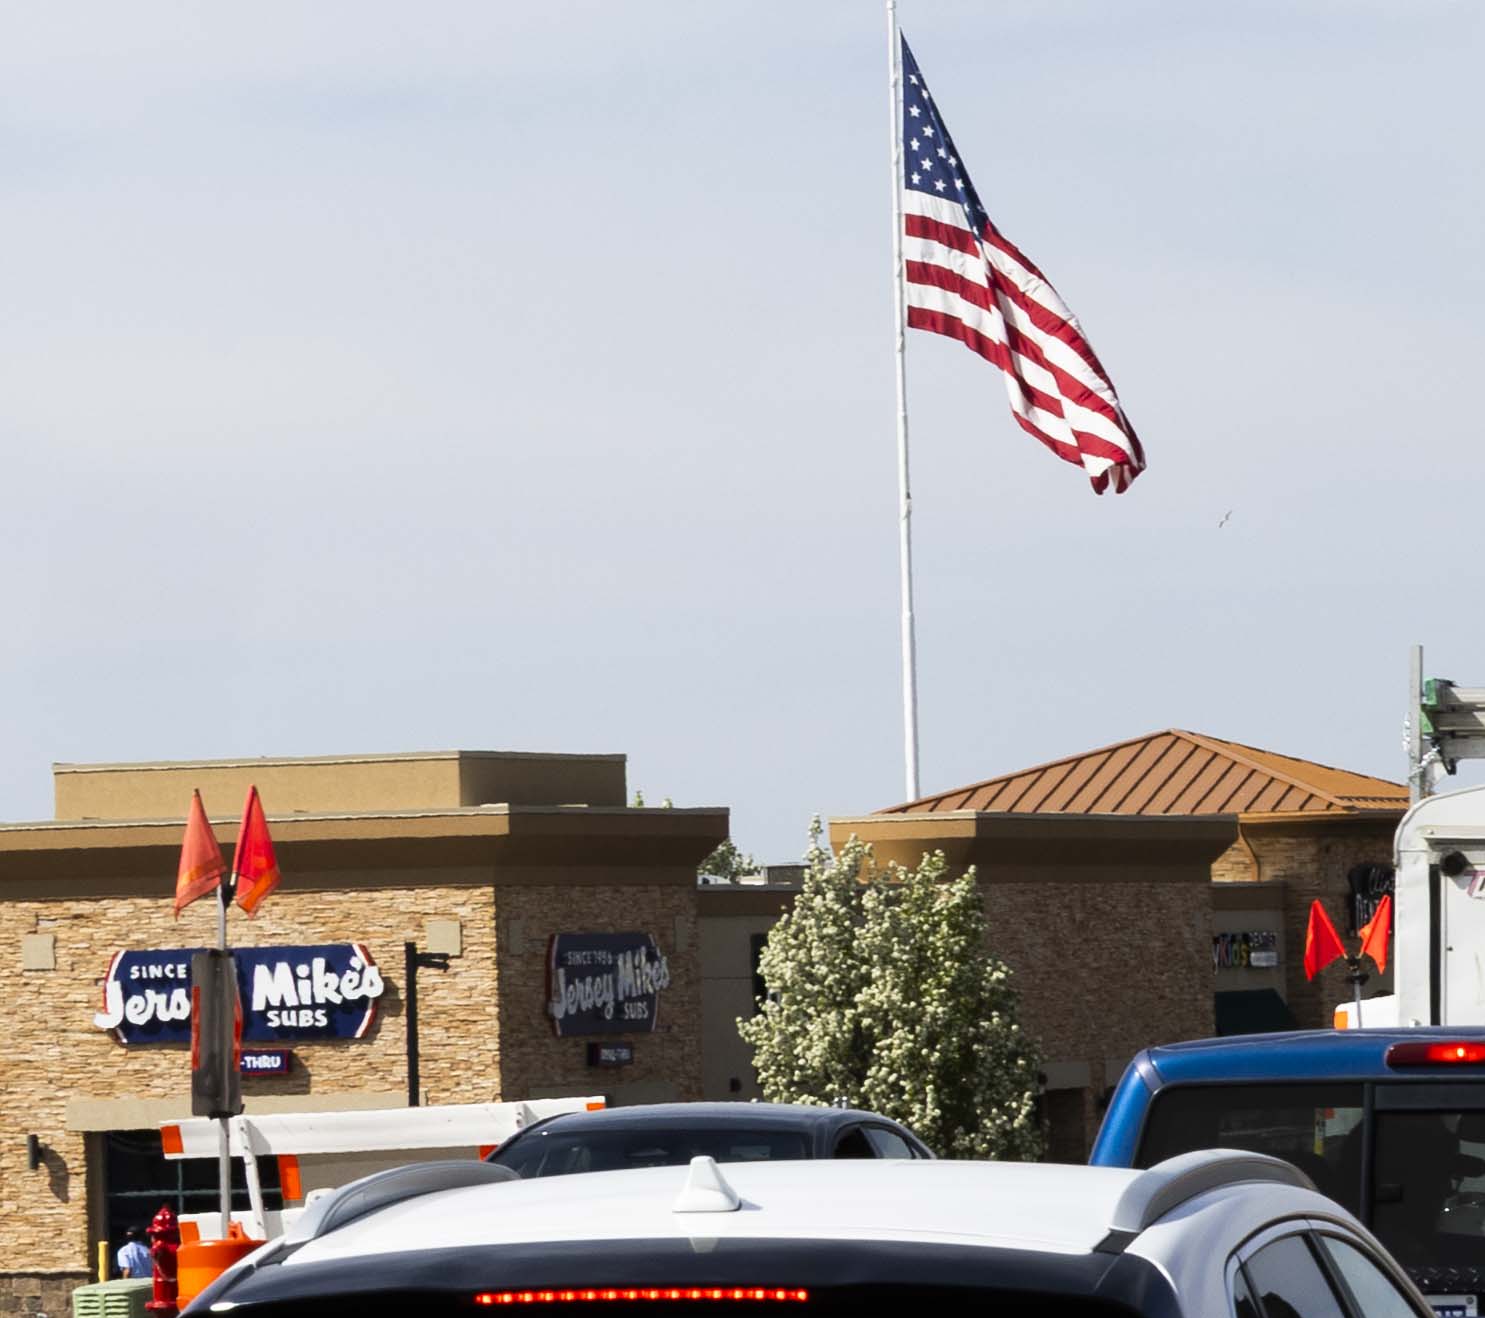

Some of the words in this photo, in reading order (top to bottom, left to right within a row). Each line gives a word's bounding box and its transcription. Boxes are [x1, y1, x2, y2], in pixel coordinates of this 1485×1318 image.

[129, 963, 188, 980] SINCE
[547, 967, 615, 1021] Jersey
[617, 945, 671, 1002] Mike's
[93, 980, 192, 1030] Jers
[252, 956, 385, 1012] Mike's
[266, 1009, 329, 1028] SUBS
[623, 1001, 649, 1020] SUBS
